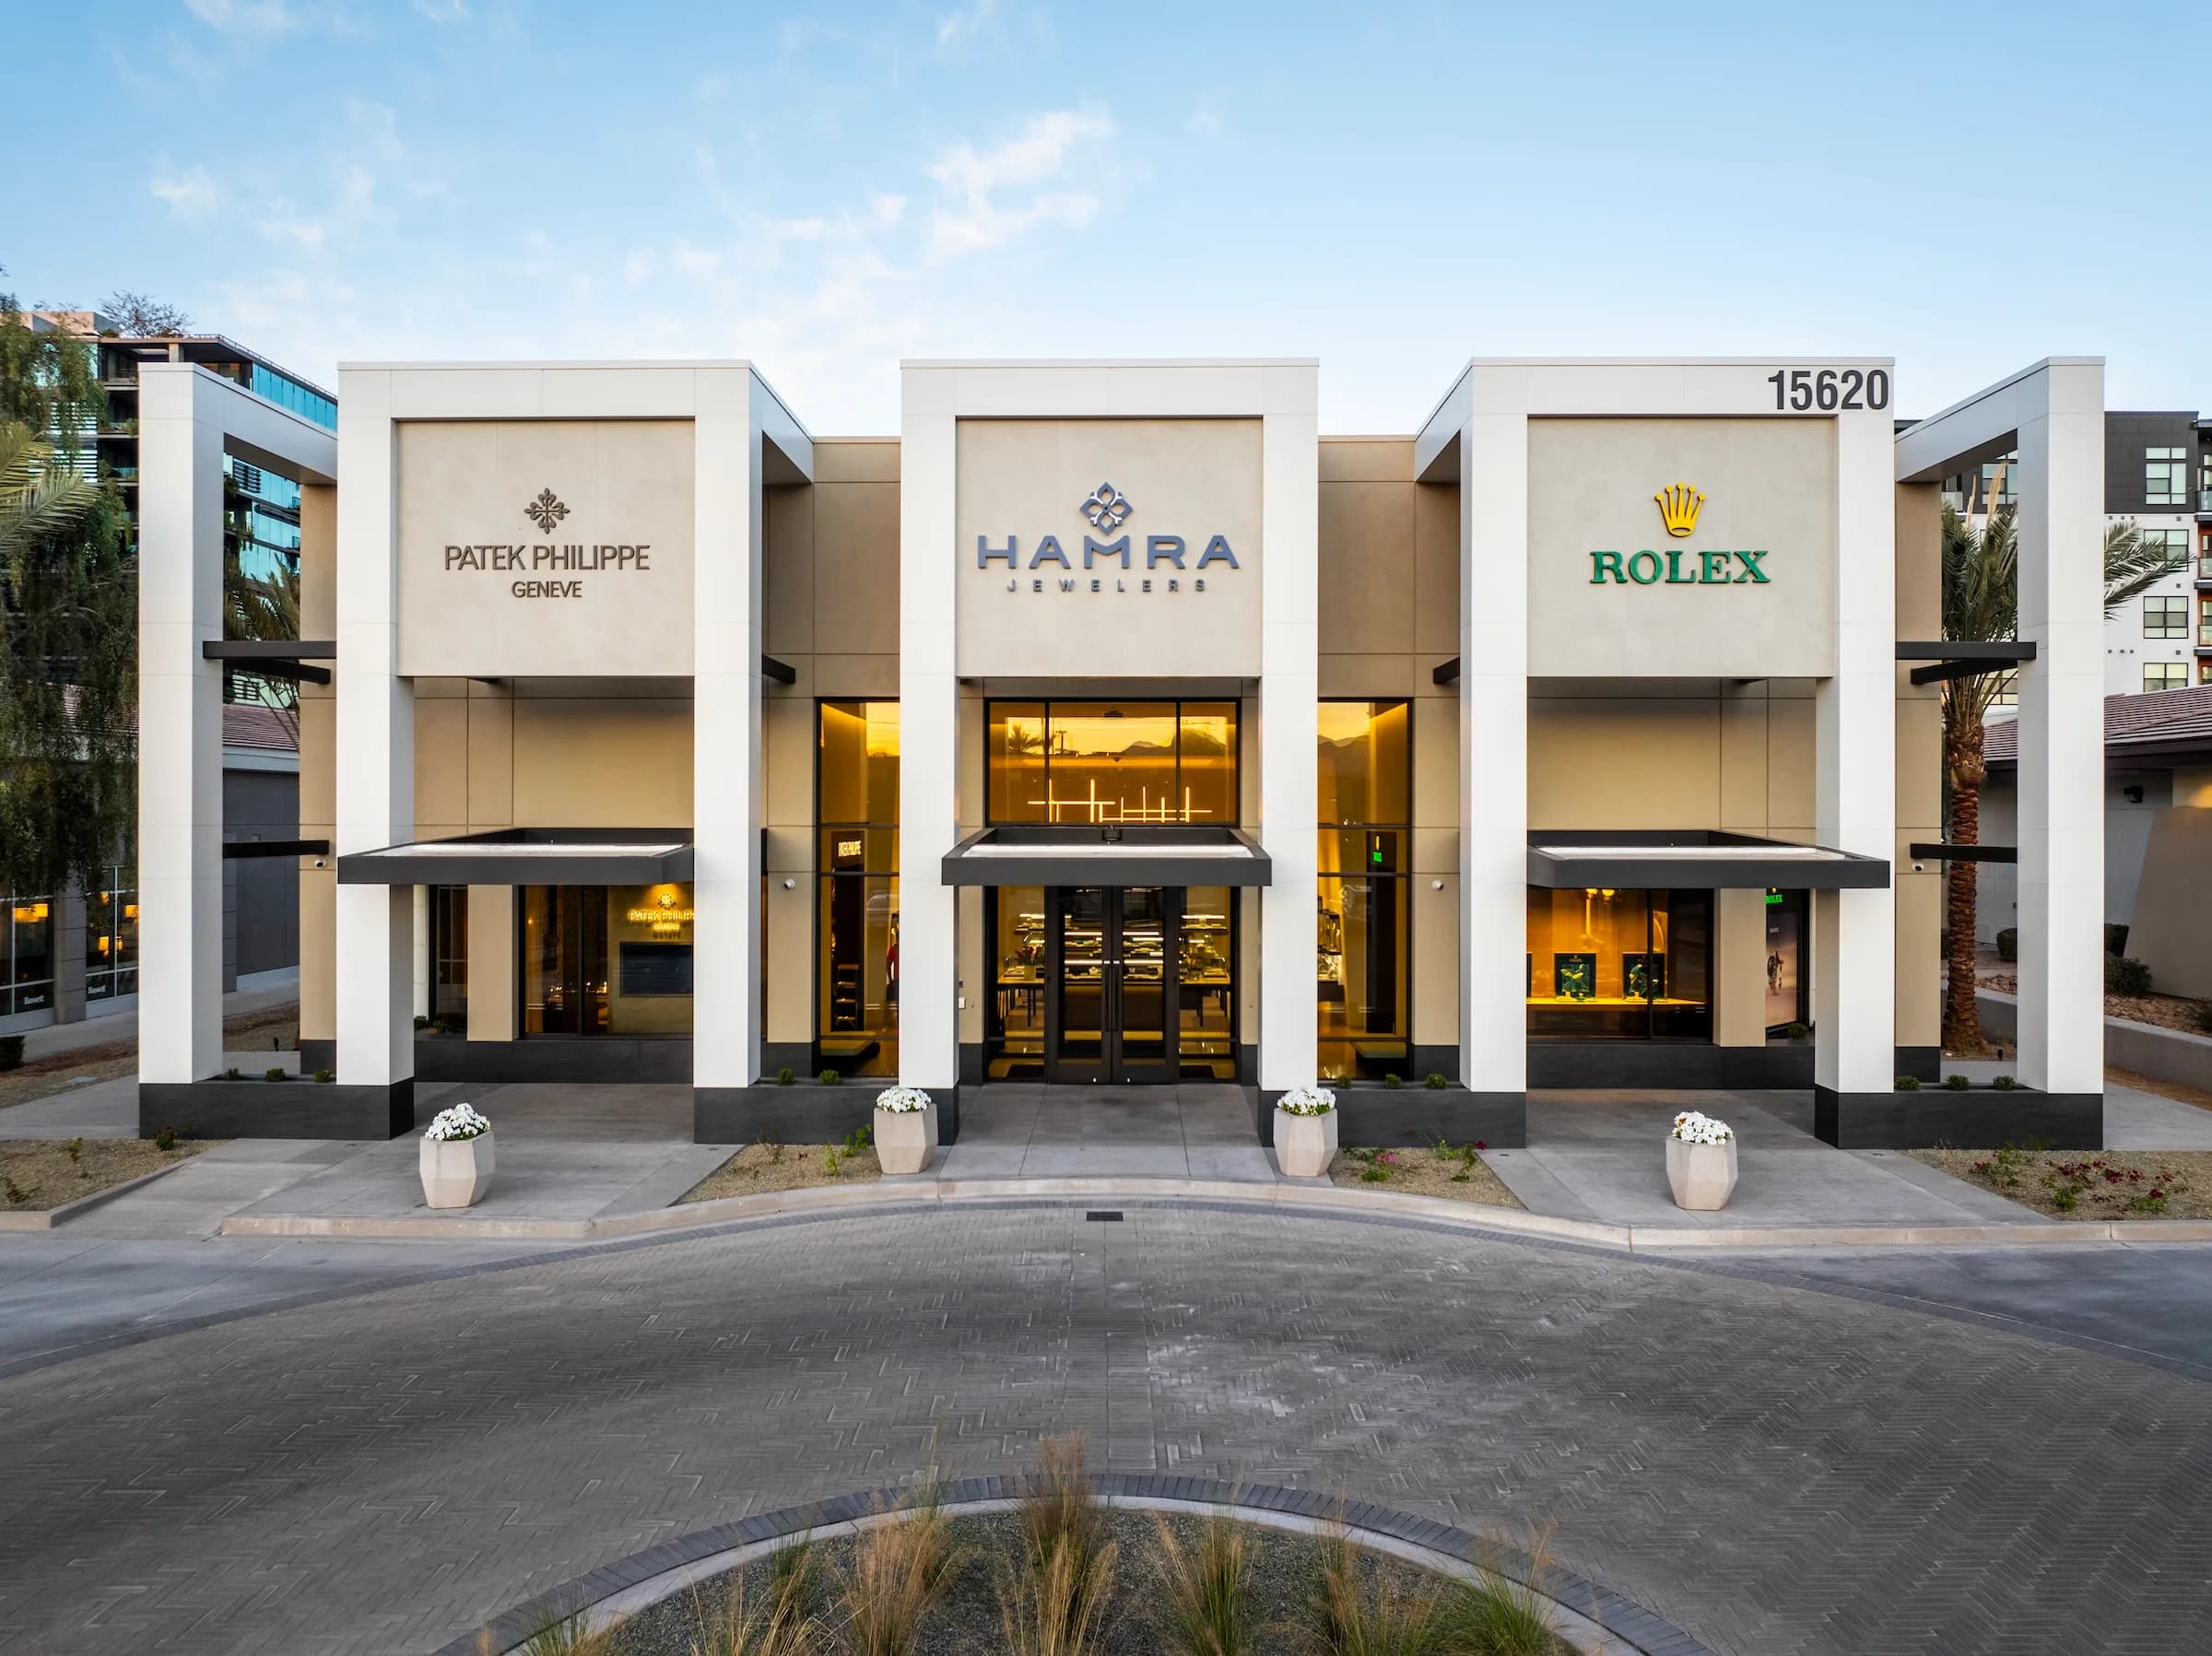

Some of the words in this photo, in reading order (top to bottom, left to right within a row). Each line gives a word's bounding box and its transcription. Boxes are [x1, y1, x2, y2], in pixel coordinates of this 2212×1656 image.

[1768, 370, 1888, 410] 15620
[444, 545, 526, 570] PATEK
[533, 545, 651, 570] PHILIPPE
[978, 534, 1240, 570] HAMRA
[1589, 549, 1771, 584] ROLEX
[512, 581, 582, 598] GENEVE
[1006, 579, 1206, 593] JEWELERS
[628, 909, 658, 922] PATEK
[662, 909, 695, 922] PHILIP
